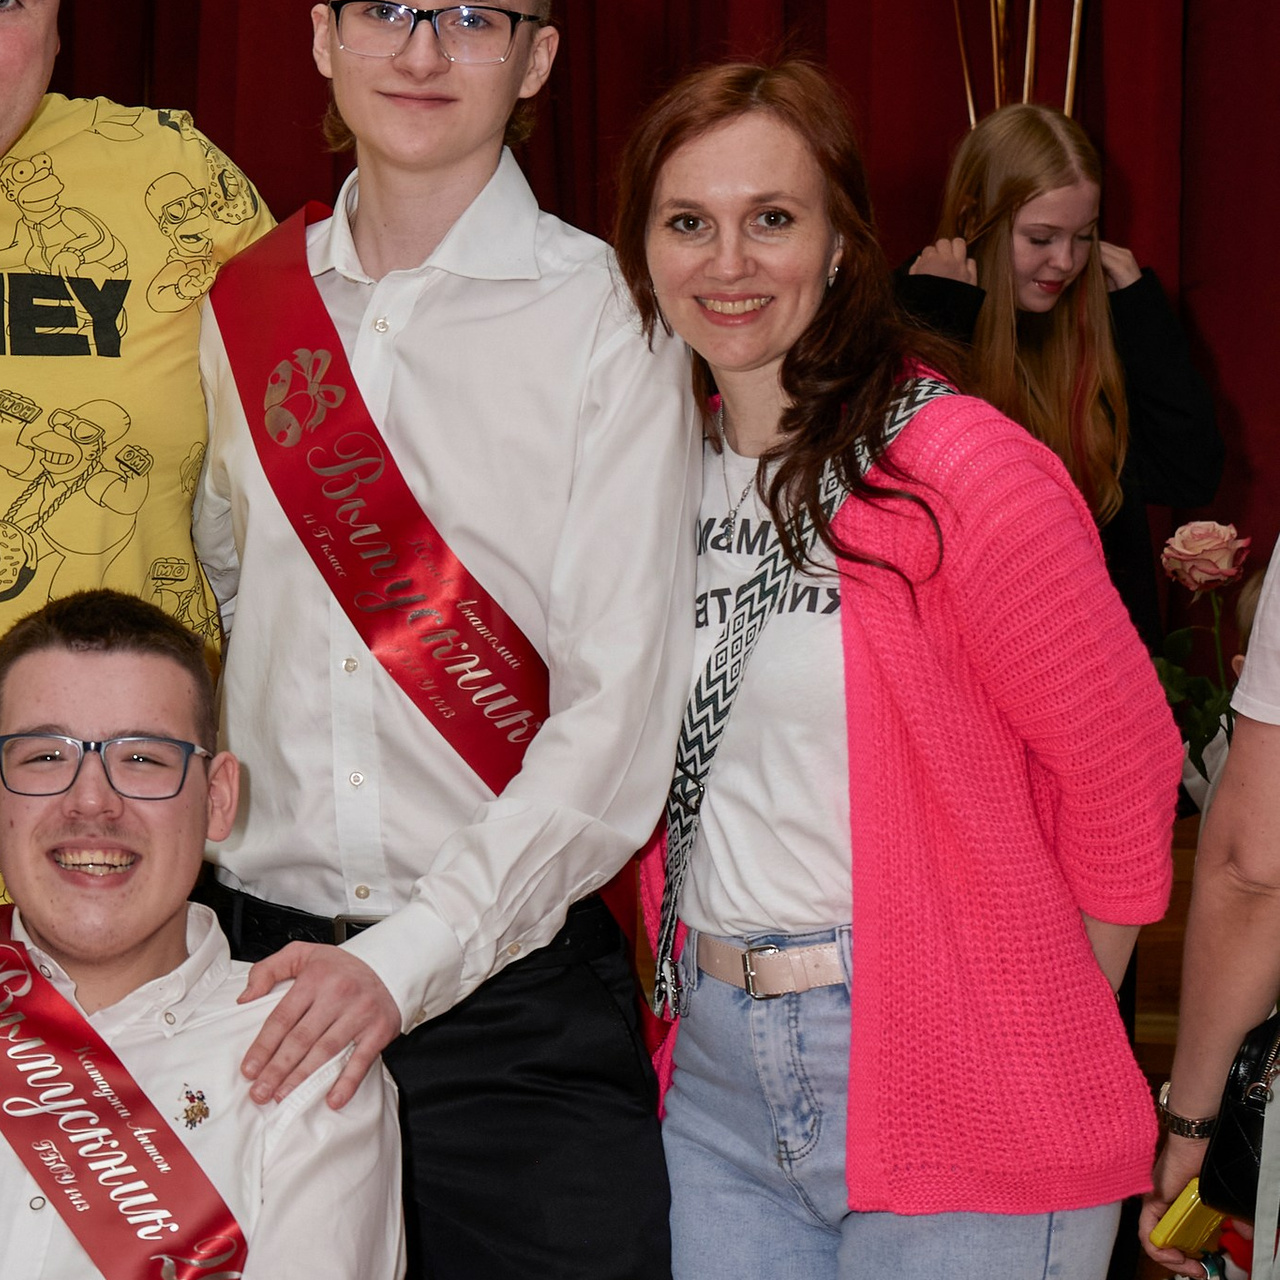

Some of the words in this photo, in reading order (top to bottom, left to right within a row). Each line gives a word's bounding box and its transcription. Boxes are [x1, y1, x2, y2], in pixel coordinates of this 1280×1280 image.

[696, 517, 772, 556] мам
[306, 431, 542, 743] Выпускник
[31, 1139, 78, 1186] ГБОУ
[126, 1120, 172, 1174] Антон
